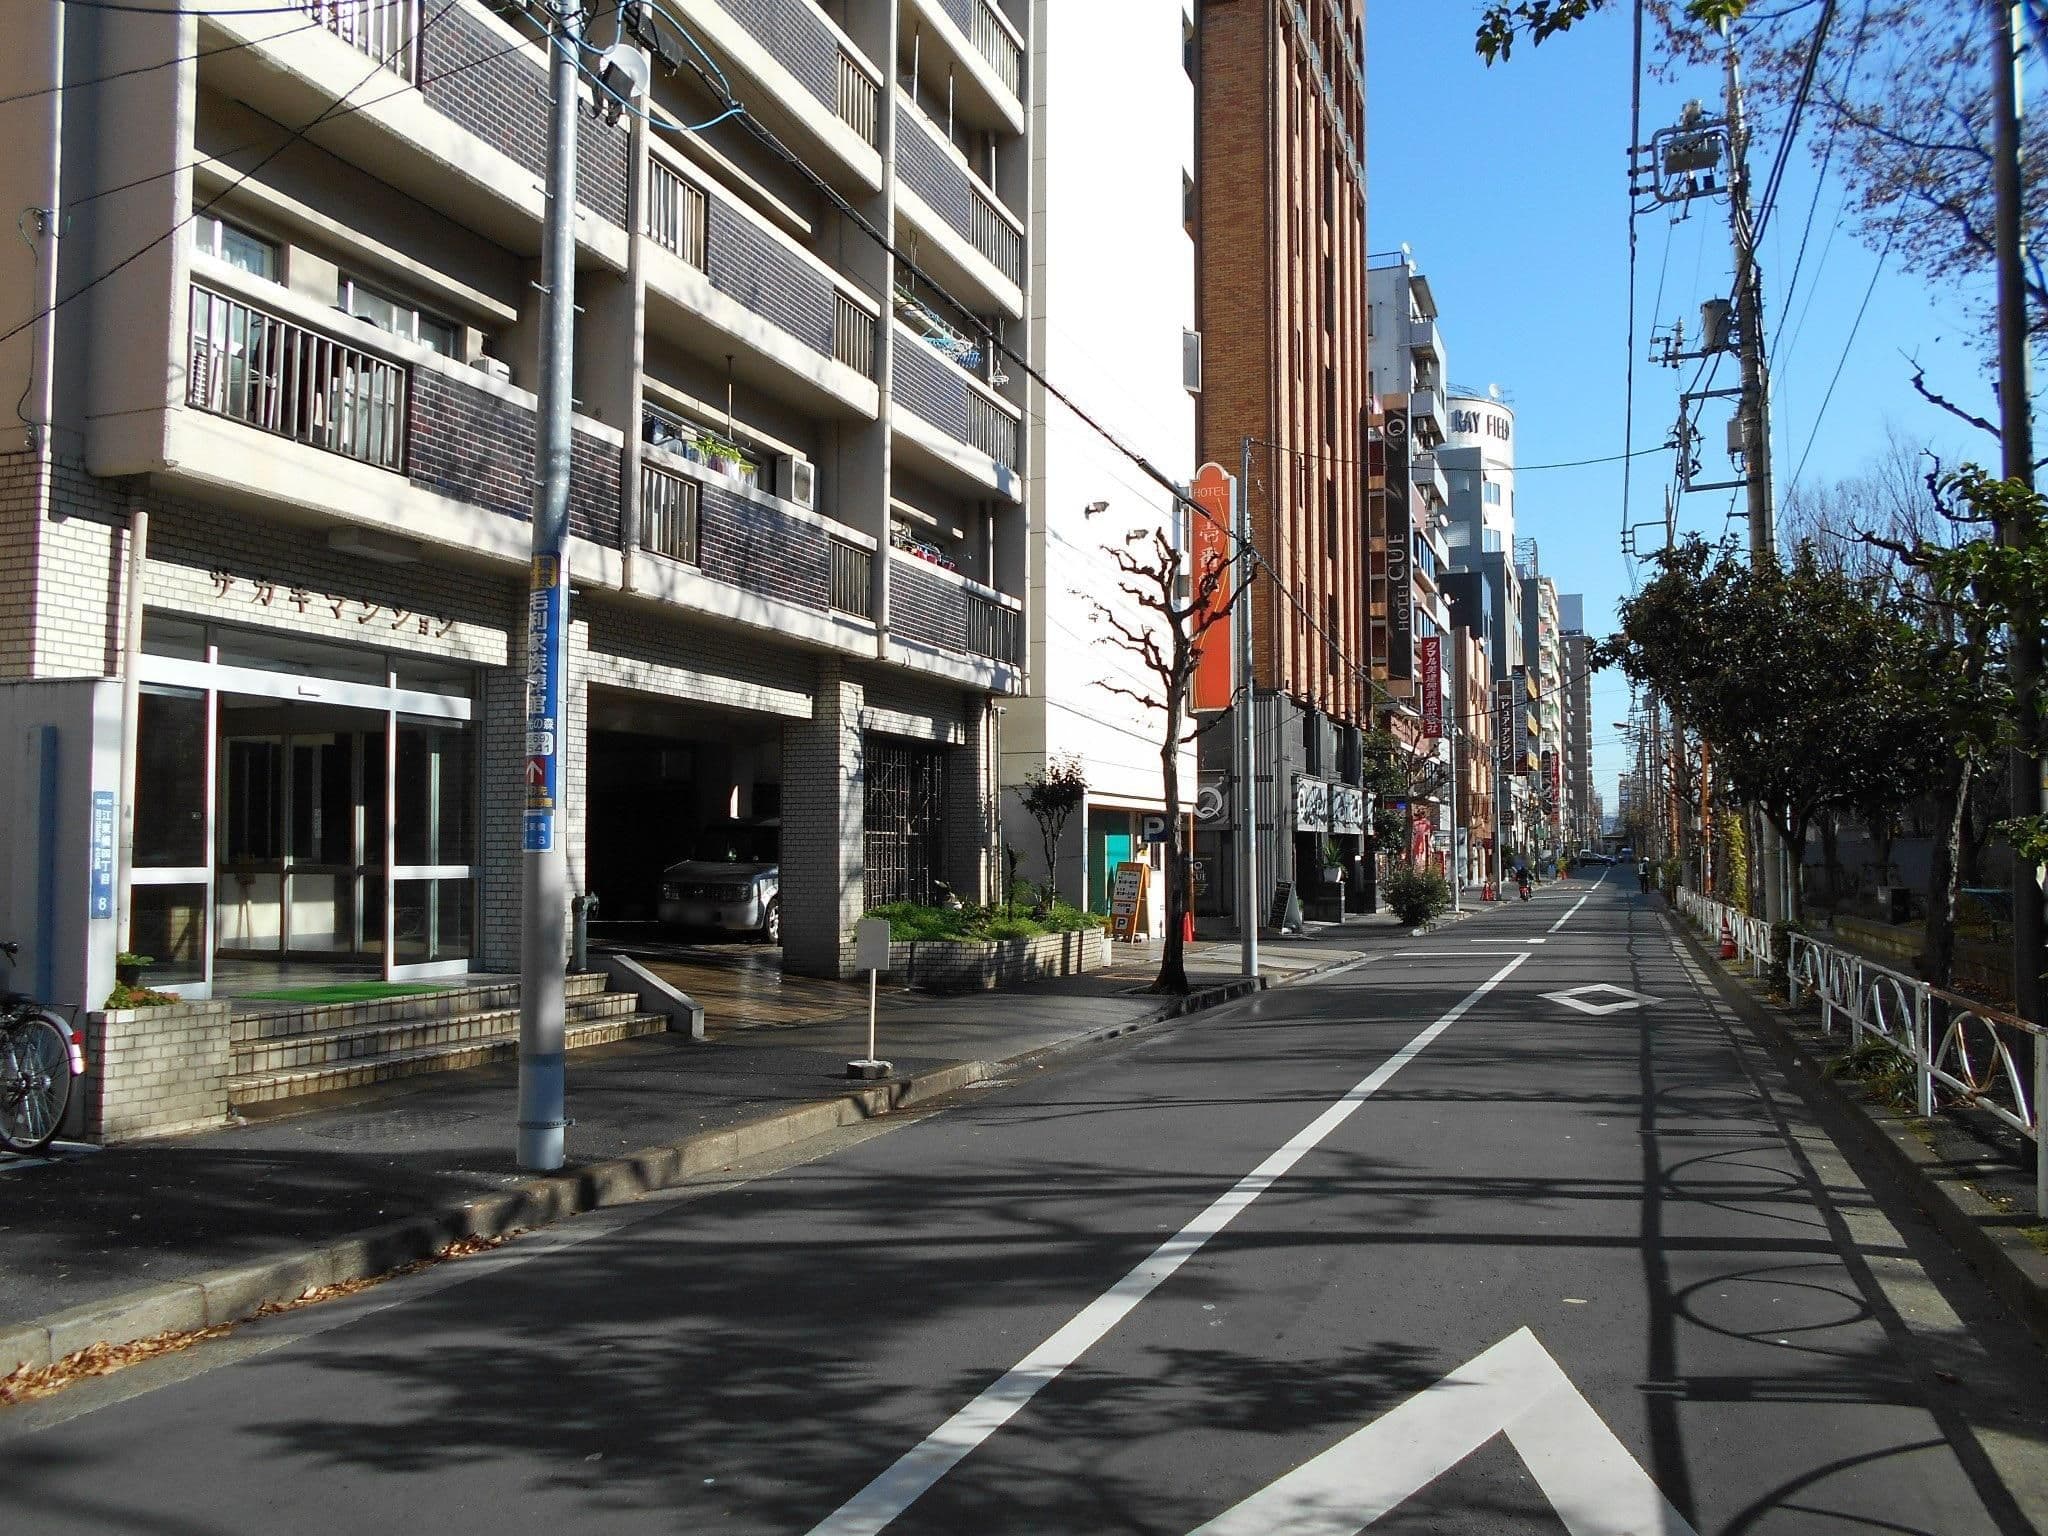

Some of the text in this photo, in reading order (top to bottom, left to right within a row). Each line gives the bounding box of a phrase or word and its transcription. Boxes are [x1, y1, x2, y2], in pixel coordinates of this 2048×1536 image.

[1486, 414, 1509, 441] FIELD
[1193, 486, 1229, 497] HOTEL
[1388, 533, 1408, 631] HOTEL CUE
[210, 570, 455, 638] サカキマンション
[1144, 816, 1165, 840] P
[98, 897, 107, 911] 8
[1117, 918, 1126, 929] P
